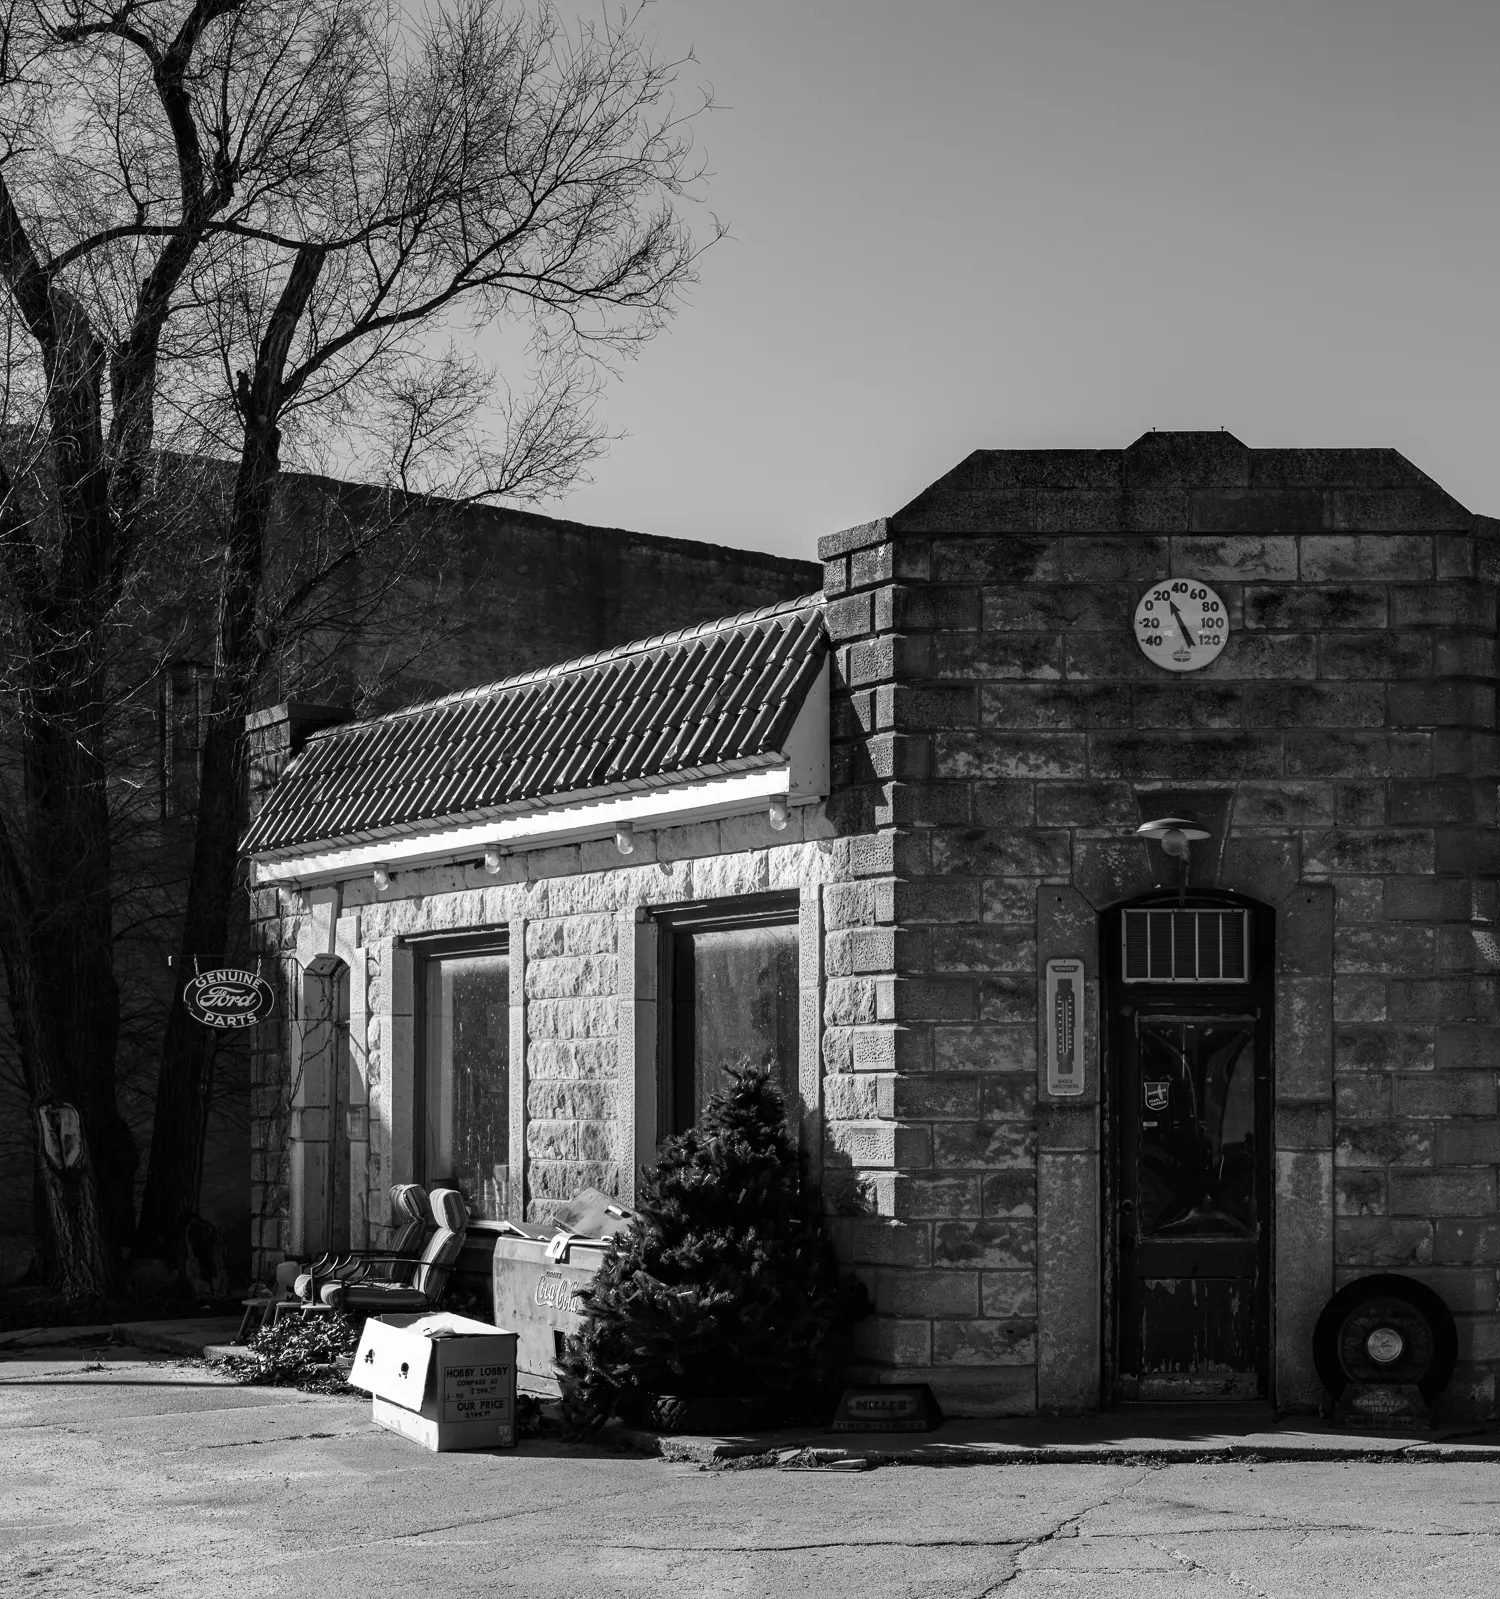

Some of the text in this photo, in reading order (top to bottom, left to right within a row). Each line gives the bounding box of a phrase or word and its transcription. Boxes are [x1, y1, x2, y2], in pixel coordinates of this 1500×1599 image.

[1171, 582, 1188, 594] 40
[1153, 590, 1171, 601] 20
[1190, 589, 1207, 600] 60
[1144, 600, 1154, 611] 0
[1202, 601, 1219, 612] 80
[1138, 617, 1160, 629] -20
[1201, 617, 1224, 628] 100
[1141, 635, 1163, 646] -40
[1199, 635, 1221, 646] 120
[195, 971, 263, 989] GENUINE
[200, 986, 256, 1007] Ford
[204, 1013, 257, 1026] PARTS
[446, 1366, 508, 1378] HOBBY LOBBY
[457, 1400, 504, 1411] OUR PRICE
